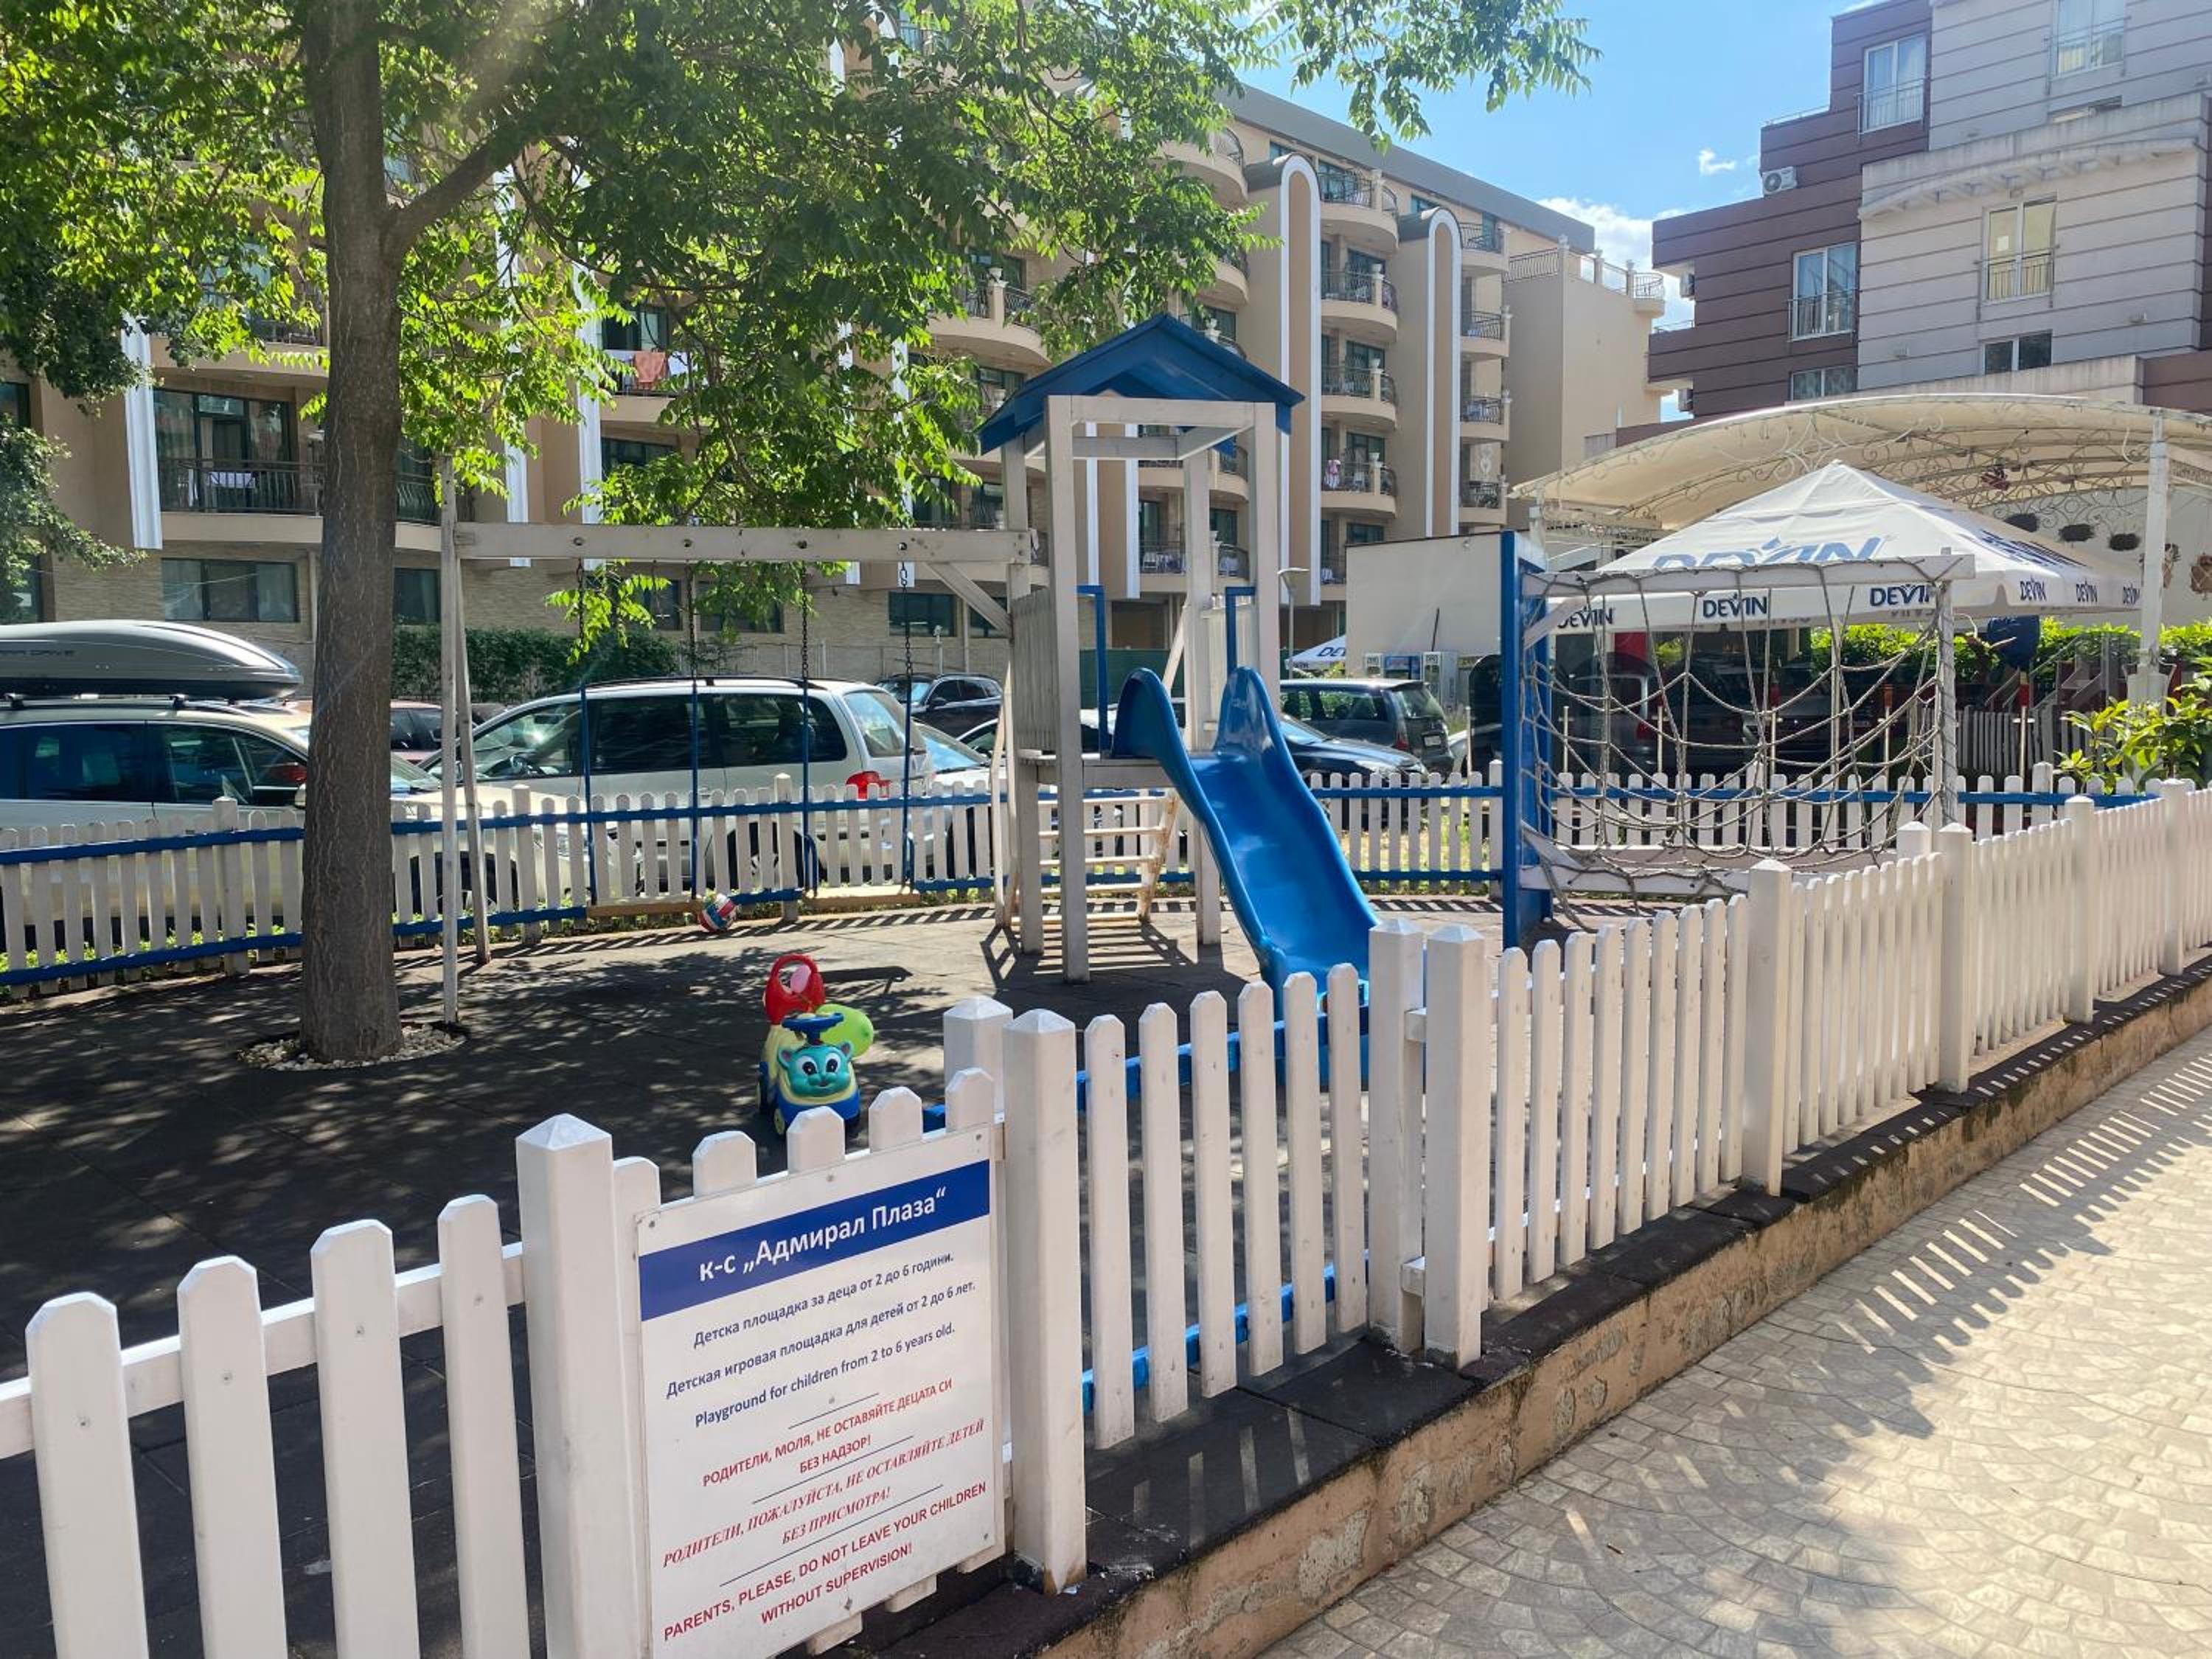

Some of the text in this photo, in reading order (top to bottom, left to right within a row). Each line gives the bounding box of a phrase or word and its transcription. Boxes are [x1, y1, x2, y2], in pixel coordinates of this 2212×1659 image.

[1703, 593, 1767, 618] DEVIN
[2020, 577, 2046, 601] DEVIN
[2076, 578, 2098, 602] DEVIN
[700, 1186, 946, 1281] к-с „Адмирал Плаза“
[667, 1281, 975, 1399] Детская игровая площадка для детей от 2 до 6 лет.
[694, 1253, 954, 1349] Детска площадка за деца от 2 до 6 години.
[695, 1322, 955, 1427] Playground for children from 2 to 6 years old.
[703, 1378, 953, 1486] РОДИТЕЛИ, МОЛЯ, НЕ ОСТАВЯЙТЕ ДЕЦАТА СИ
[800, 1435, 871, 1474] БЕЗ НАДЗОР!
[664, 1417, 984, 1568] РОДИТЕЛИ, ПОЖАЛУЙСТА, НЕ ОСТАВЛЯЙТЕ ДЕТЕЙ
[782, 1486, 891, 1544] БЕЗ ПРИСМОТРА!
[664, 1481, 987, 1641] PARENTS, PLEASE, DO NOT LEAVE YOUR CHILDREN
[761, 1541, 912, 1625] WITHOUT SUPERVISION!
